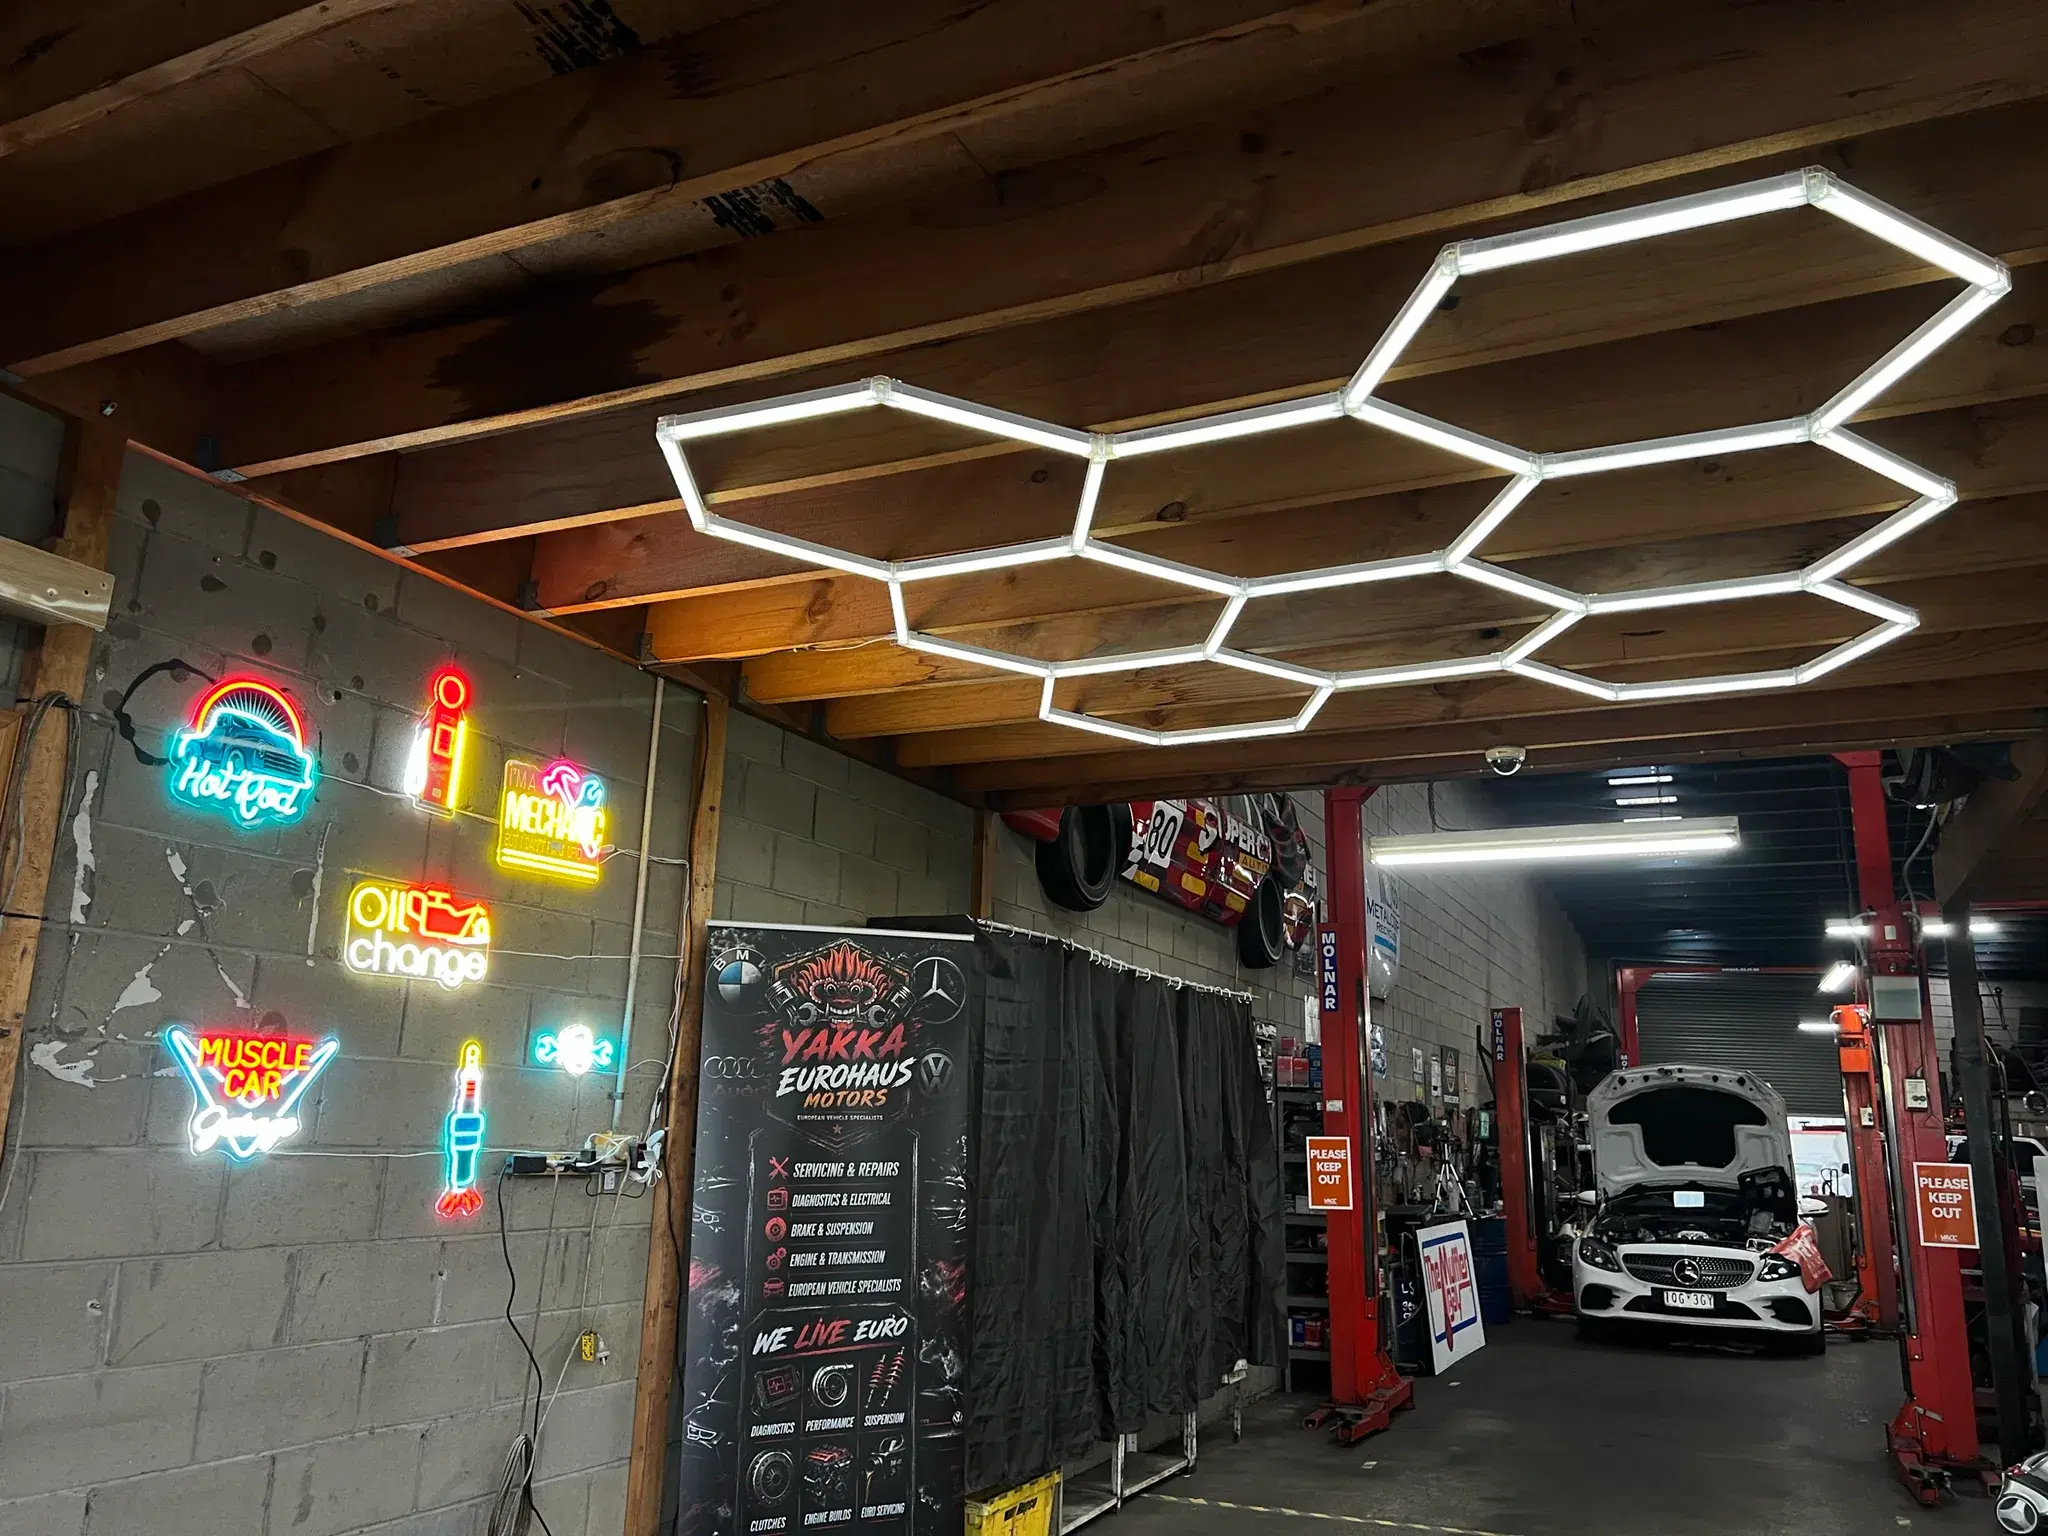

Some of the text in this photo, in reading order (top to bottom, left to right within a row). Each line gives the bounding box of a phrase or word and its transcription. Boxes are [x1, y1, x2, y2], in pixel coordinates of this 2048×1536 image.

[178, 756, 302, 820] Hot Rod
[504, 791, 606, 842] MECHAC
[1147, 809, 1177, 859] 80
[353, 886, 410, 933] Oil
[349, 928, 487, 987] change
[1321, 932, 1337, 1010] MOLNAR
[780, 1022, 908, 1064] YAKKA
[1493, 1011, 1504, 1061] MOLNAR
[196, 1037, 313, 1071] MUSCLE
[224, 1069, 282, 1099] CAR
[776, 1056, 917, 1098] EUROHAUS
[804, 1088, 888, 1108] MOTORS
[1310, 1149, 1347, 1159] PLEASE
[793, 1161, 900, 1178] SERVICING & REPAIRS
[1316, 1162, 1342, 1172] KEEP
[1318, 1175, 1341, 1184] OUT
[1919, 1177, 1969, 1190] PLEASE
[792, 1192, 892, 1208] DIAGNOSTICS & ELECTRICAL
[1928, 1192, 1962, 1204] KEEP
[1931, 1207, 1962, 1219] OUT
[790, 1222, 874, 1238] BRAKE & SUSPENSION
[790, 1250, 886, 1267] ENGINE & TRANSMISSION
[788, 1278, 902, 1297] EUROPEAN VEHICLE SPECIALISTS
[752, 1315, 908, 1356] WE LIVE EURO
[805, 1416, 854, 1432] PERFORMANCE
[864, 1412, 905, 1426] SUSPENSION
[750, 1422, 796, 1437] DIAGNOSTICS
[804, 1508, 852, 1526] ENGINE BUILDS
[860, 1502, 905, 1518] EURO SERVICING
[750, 1517, 787, 1532] CLUTCHES
